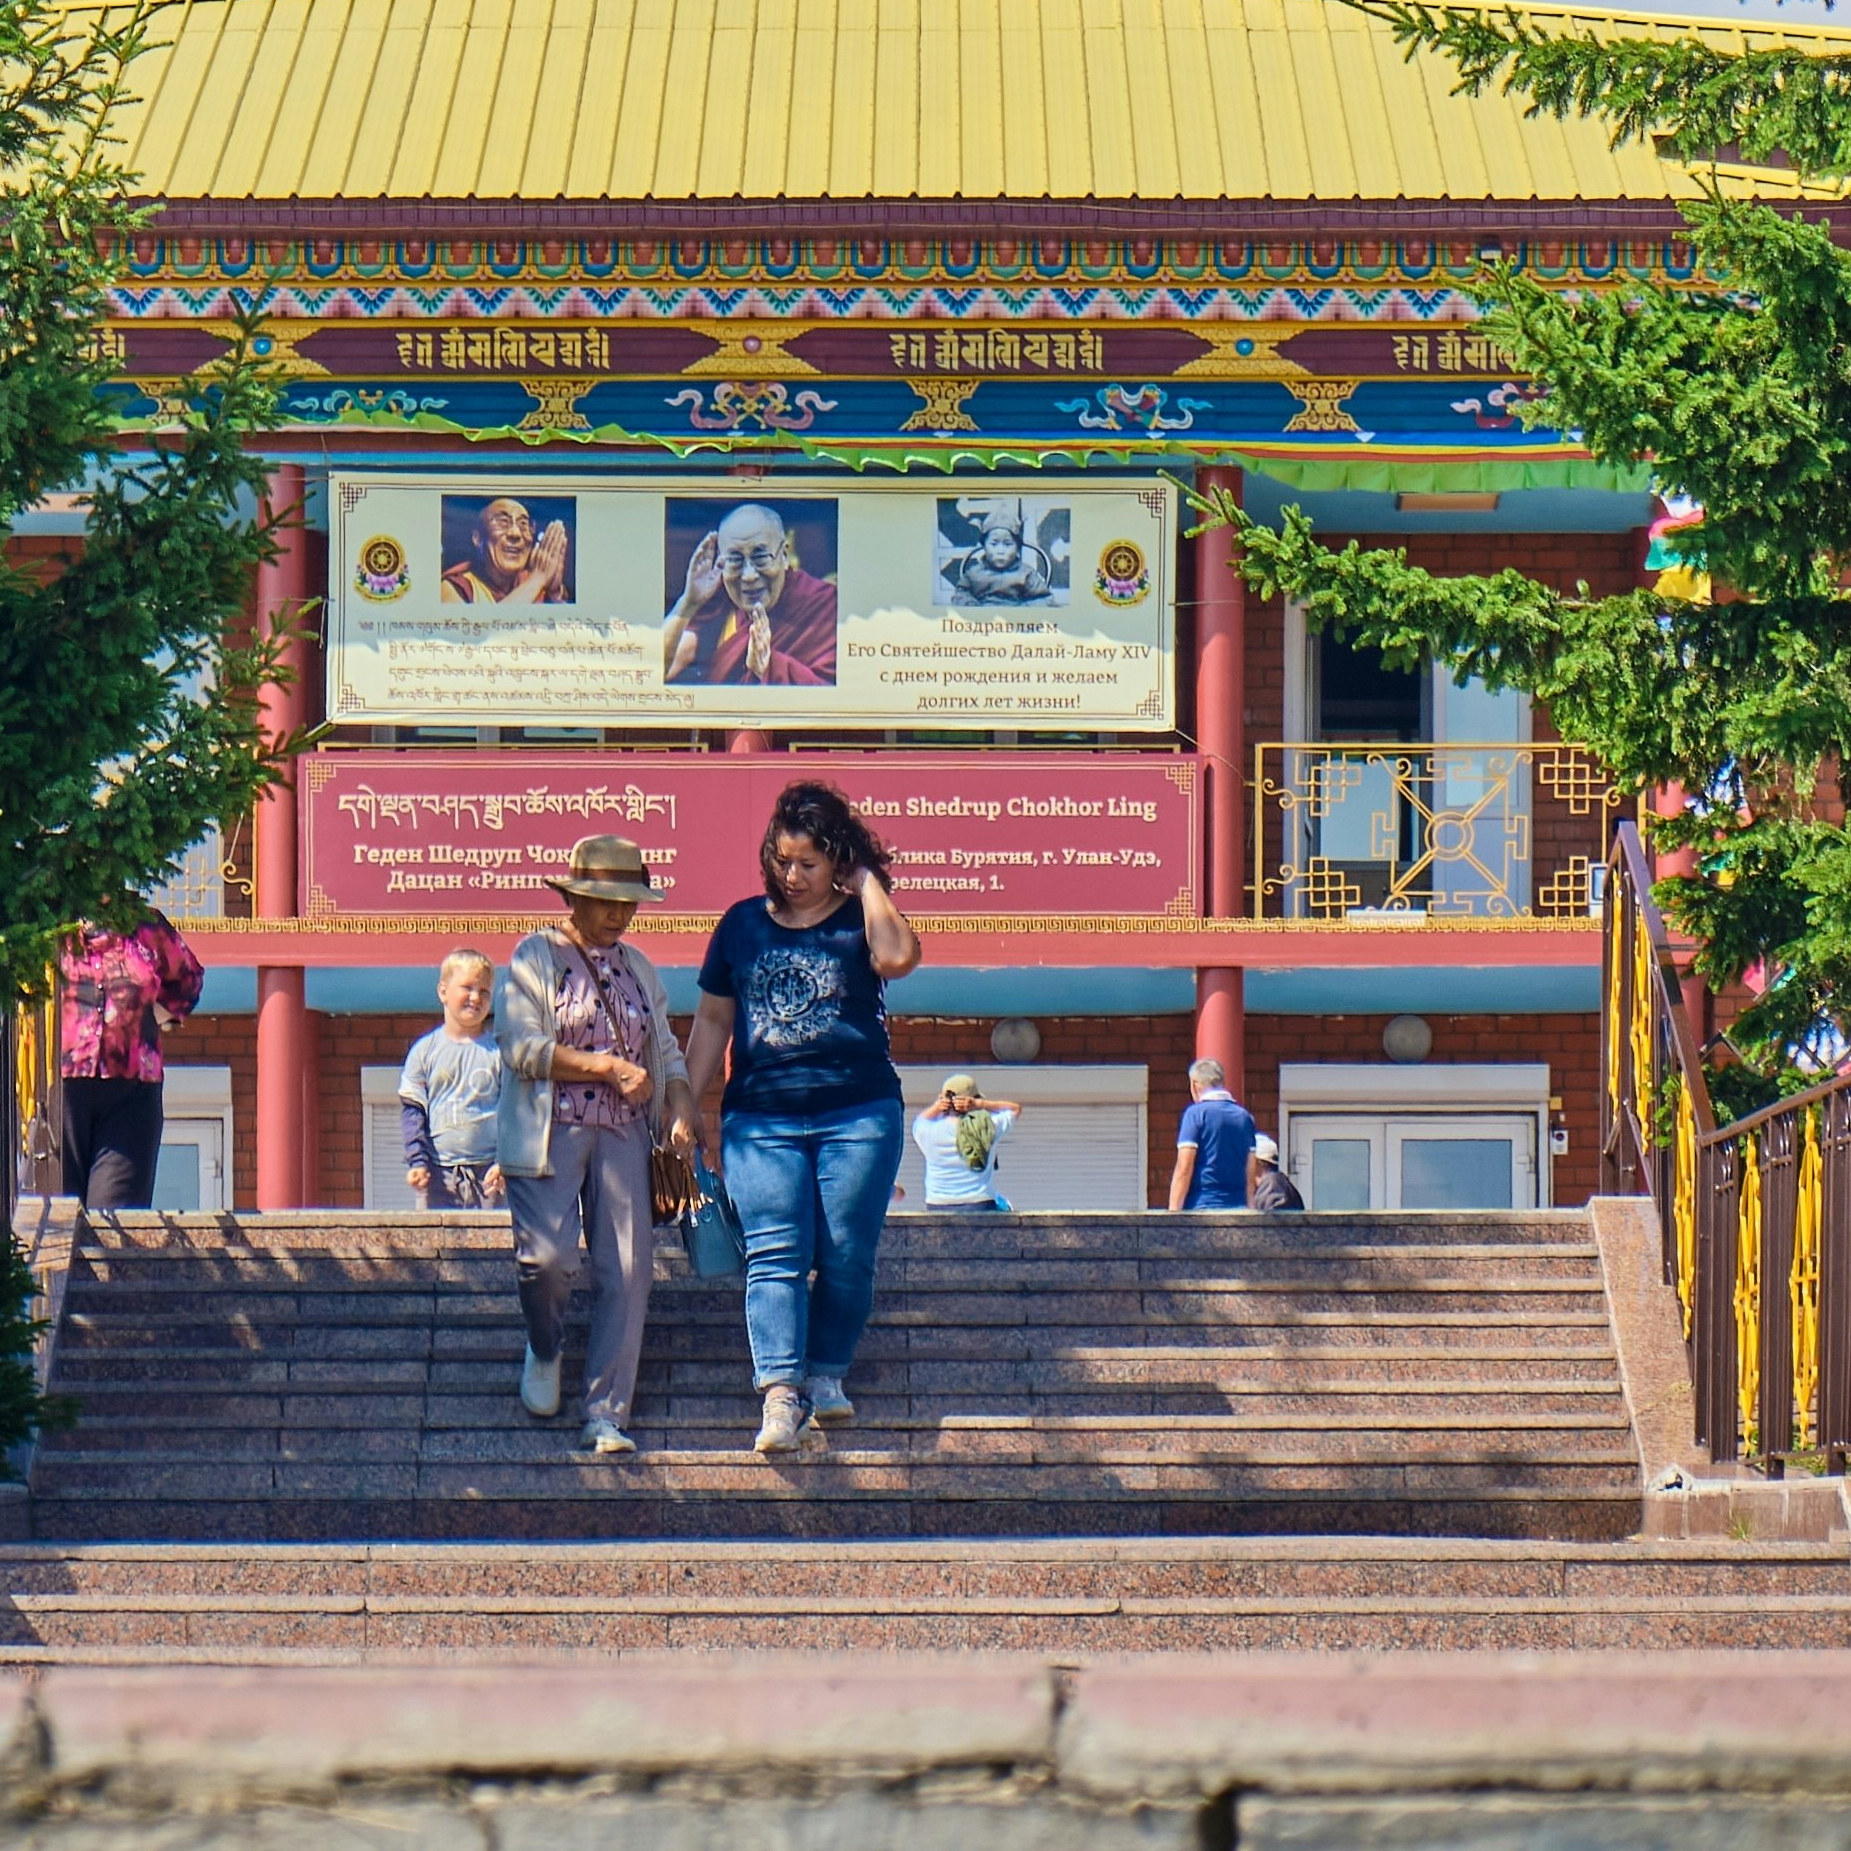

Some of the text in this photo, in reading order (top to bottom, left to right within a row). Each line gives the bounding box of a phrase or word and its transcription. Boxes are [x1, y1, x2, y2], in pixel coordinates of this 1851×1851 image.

[941, 618, 1058, 637] Поздравляем
[847, 643, 1152, 663] Его Святейшество Далай-Ламу XIV
[880, 671, 1118, 686] с днем рождения и желаем
[917, 694, 1081, 711] долгих лет жизни!
[849, 796, 1157, 821] eden Shedrup Chokhor Ling
[354, 845, 423, 866] Геден
[429, 845, 521, 868] Шедруп
[526, 844, 571, 863] Чок
[888, 846, 1161, 869] блика Бурятия, г. Улан-Удэ,
[386, 870, 462, 892] Дацан
[891, 874, 1005, 893] релецкая, 1.
